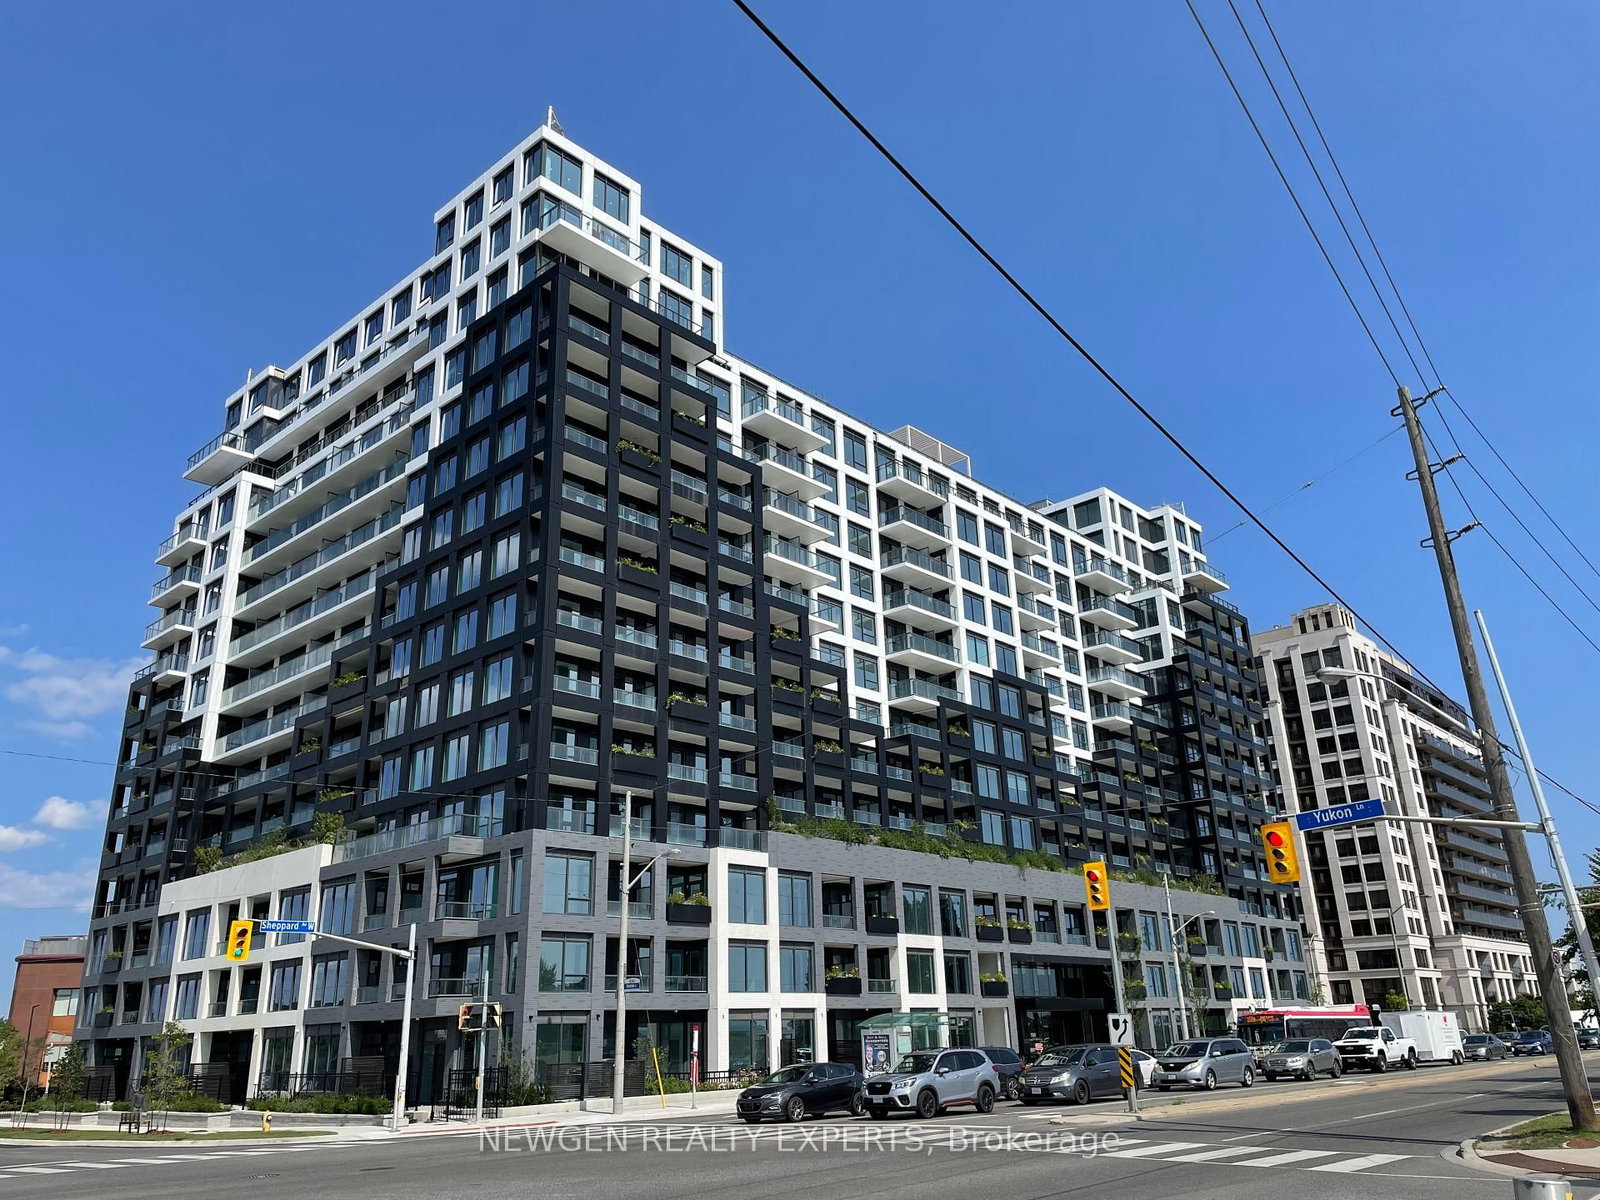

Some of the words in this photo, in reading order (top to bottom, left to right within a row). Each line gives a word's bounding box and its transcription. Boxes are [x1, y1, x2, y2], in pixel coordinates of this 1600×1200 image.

[1313, 808, 1353, 823] Yukon
[261, 921, 299, 930] Sheppard
[308, 922, 314, 930] W
